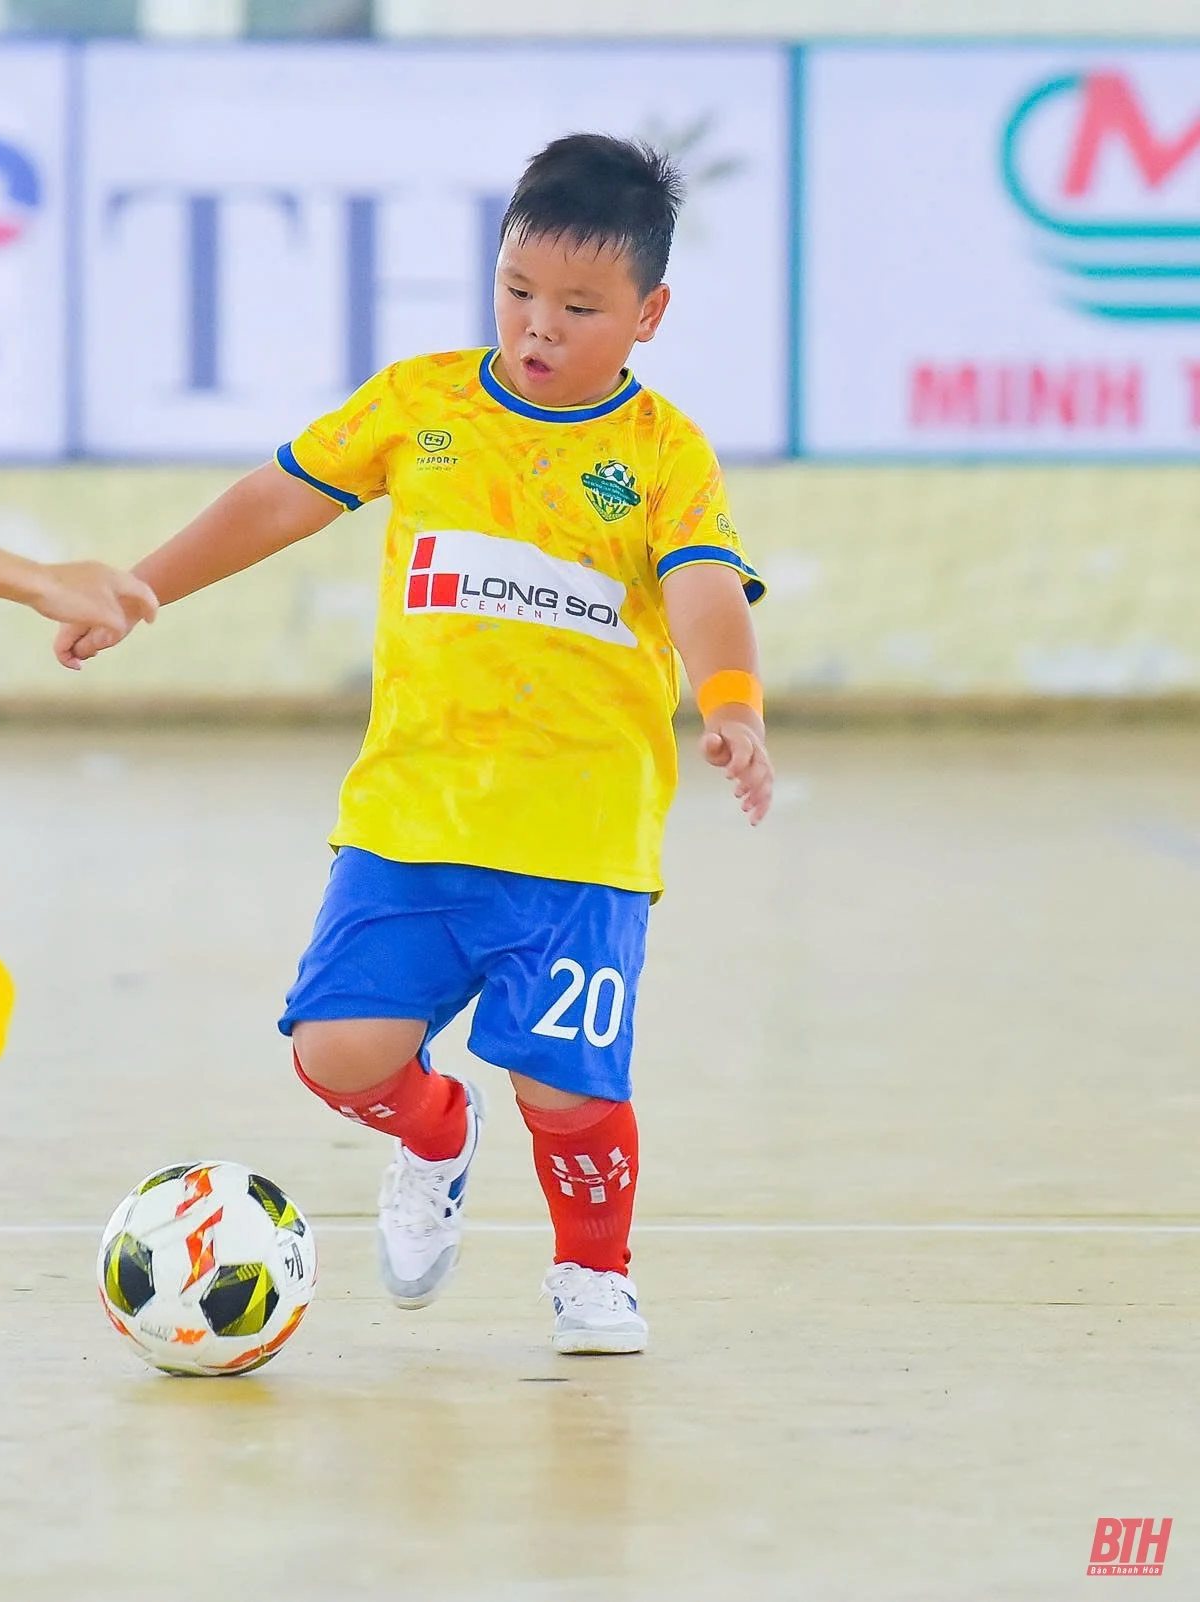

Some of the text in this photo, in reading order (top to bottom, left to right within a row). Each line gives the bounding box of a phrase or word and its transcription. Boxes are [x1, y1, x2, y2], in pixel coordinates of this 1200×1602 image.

[910, 363, 1142, 430] MINH
[460, 598, 561, 623] CEMENT
[461, 573, 559, 609] LONG
[530, 957, 626, 1048] 20
